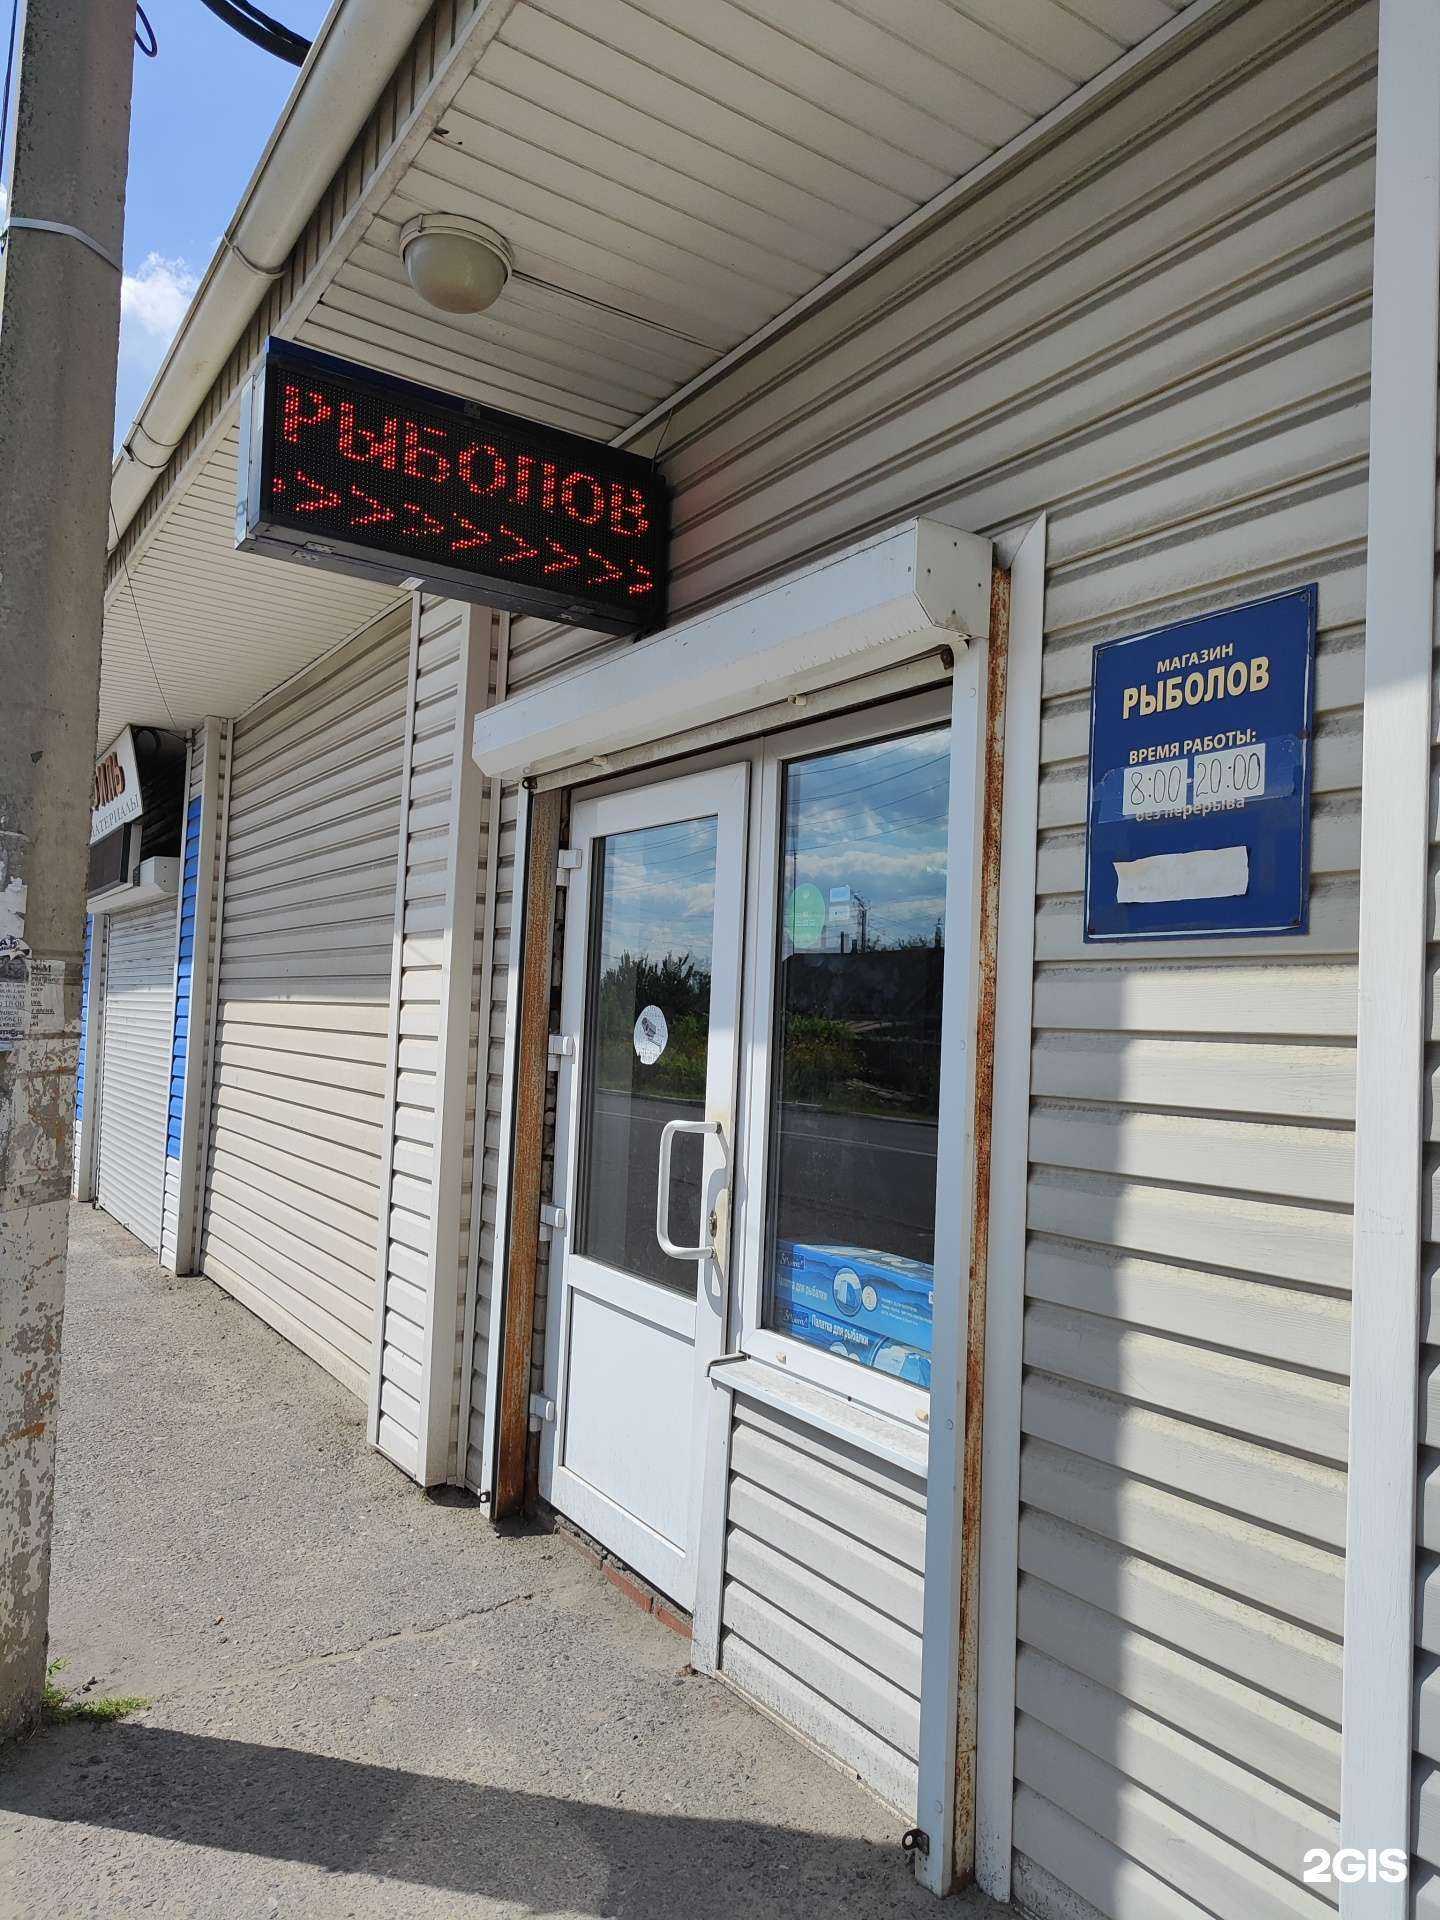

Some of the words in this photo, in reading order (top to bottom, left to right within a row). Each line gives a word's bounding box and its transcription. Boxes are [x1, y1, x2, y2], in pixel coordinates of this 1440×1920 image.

[283, 384, 650, 538] РЫБОЛОВ
[1156, 642, 1234, 674] МАГАЗИН
[1122, 655, 1270, 719] РЫБОЛОВ
[1129, 742, 1180, 765] ВРЕМЯ
[1183, 728, 1257, 755] РАБОТЫ:
[91, 794, 140, 838] АТЕРИАЛЫ
